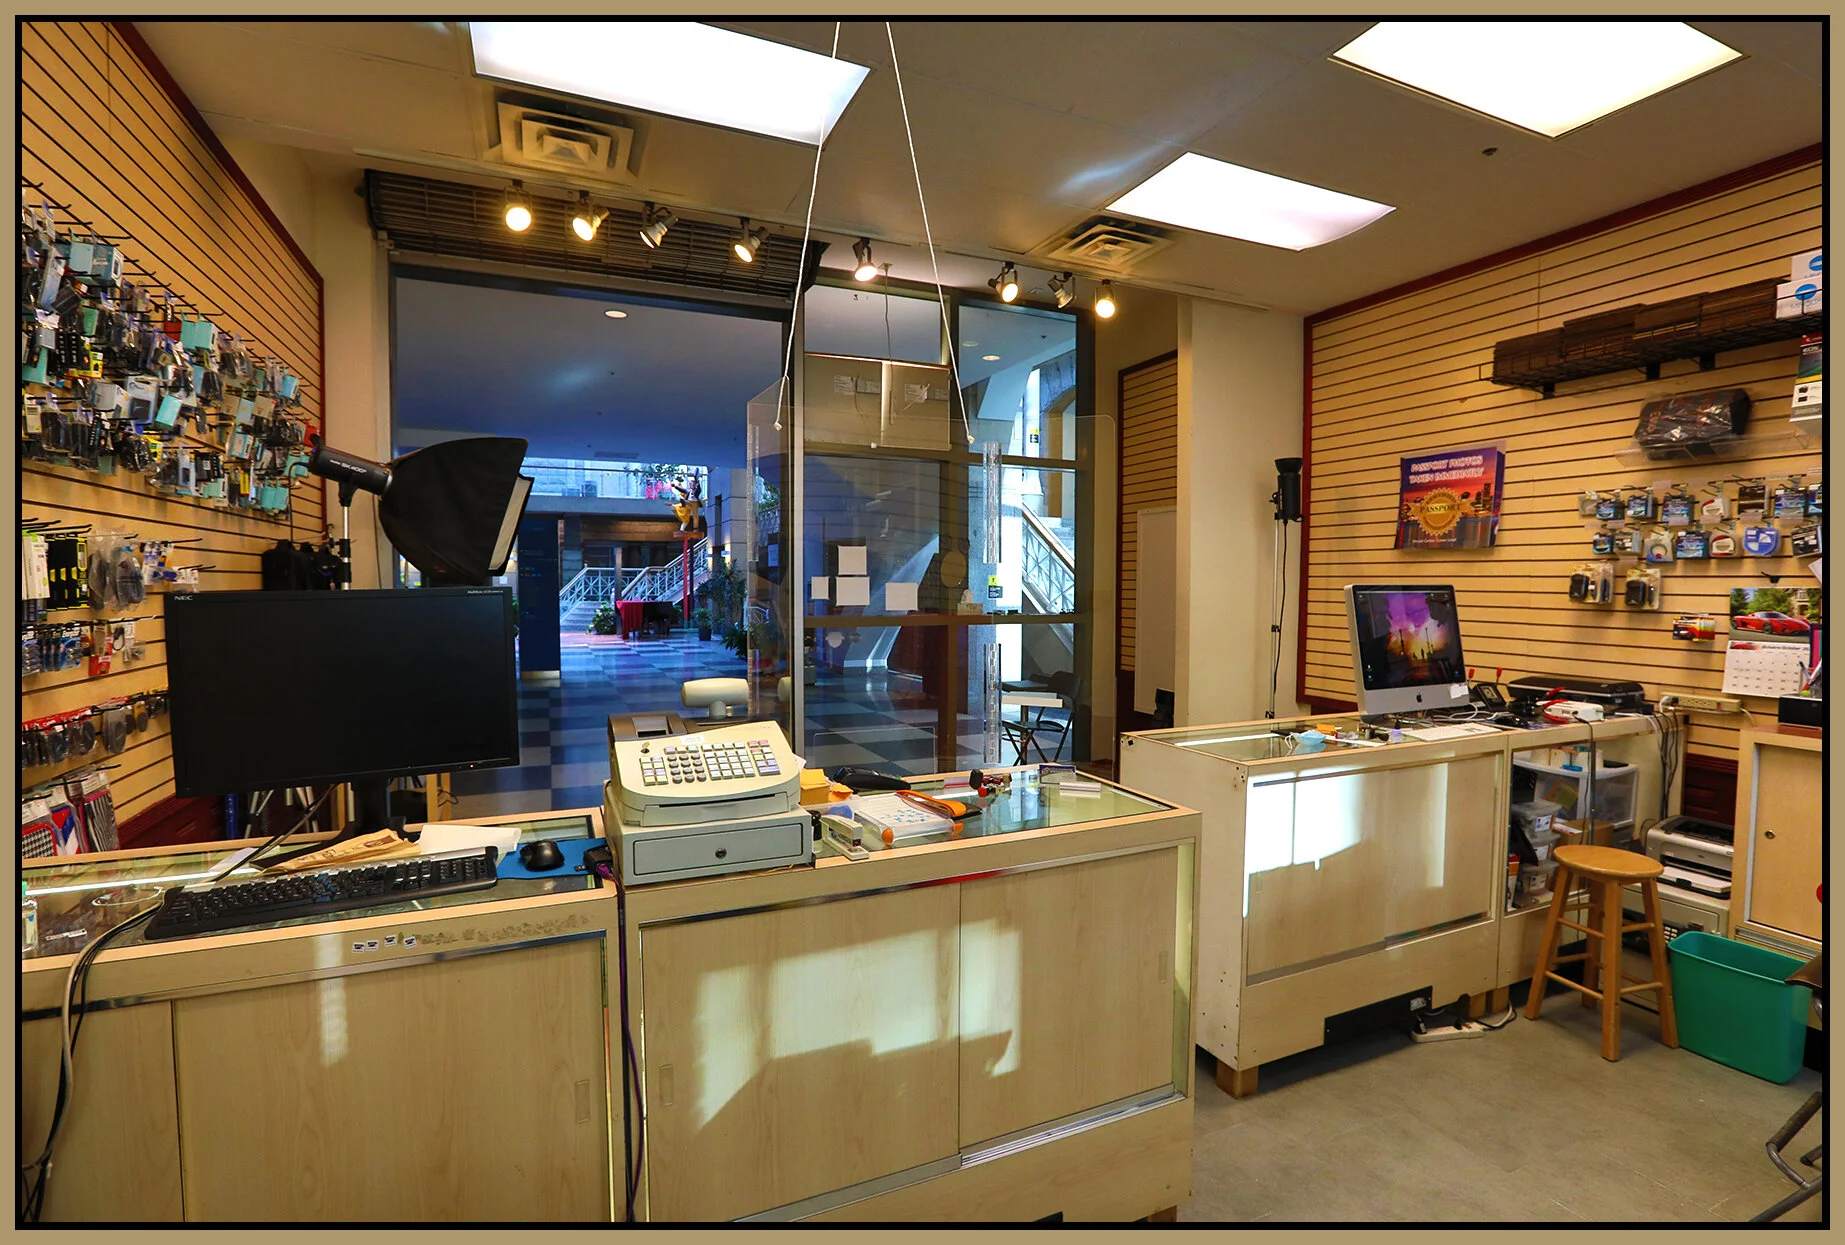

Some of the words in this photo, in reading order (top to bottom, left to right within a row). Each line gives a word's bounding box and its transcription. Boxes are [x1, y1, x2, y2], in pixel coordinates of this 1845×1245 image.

[1411, 460, 1448, 472] PASSPORT
[1449, 455, 1483, 468] PHOTOS
[1409, 473, 1434, 484] TAKEN
[1435, 467, 1484, 481] IMMEDIATELY
[1420, 503, 1460, 513] PASSPORT
